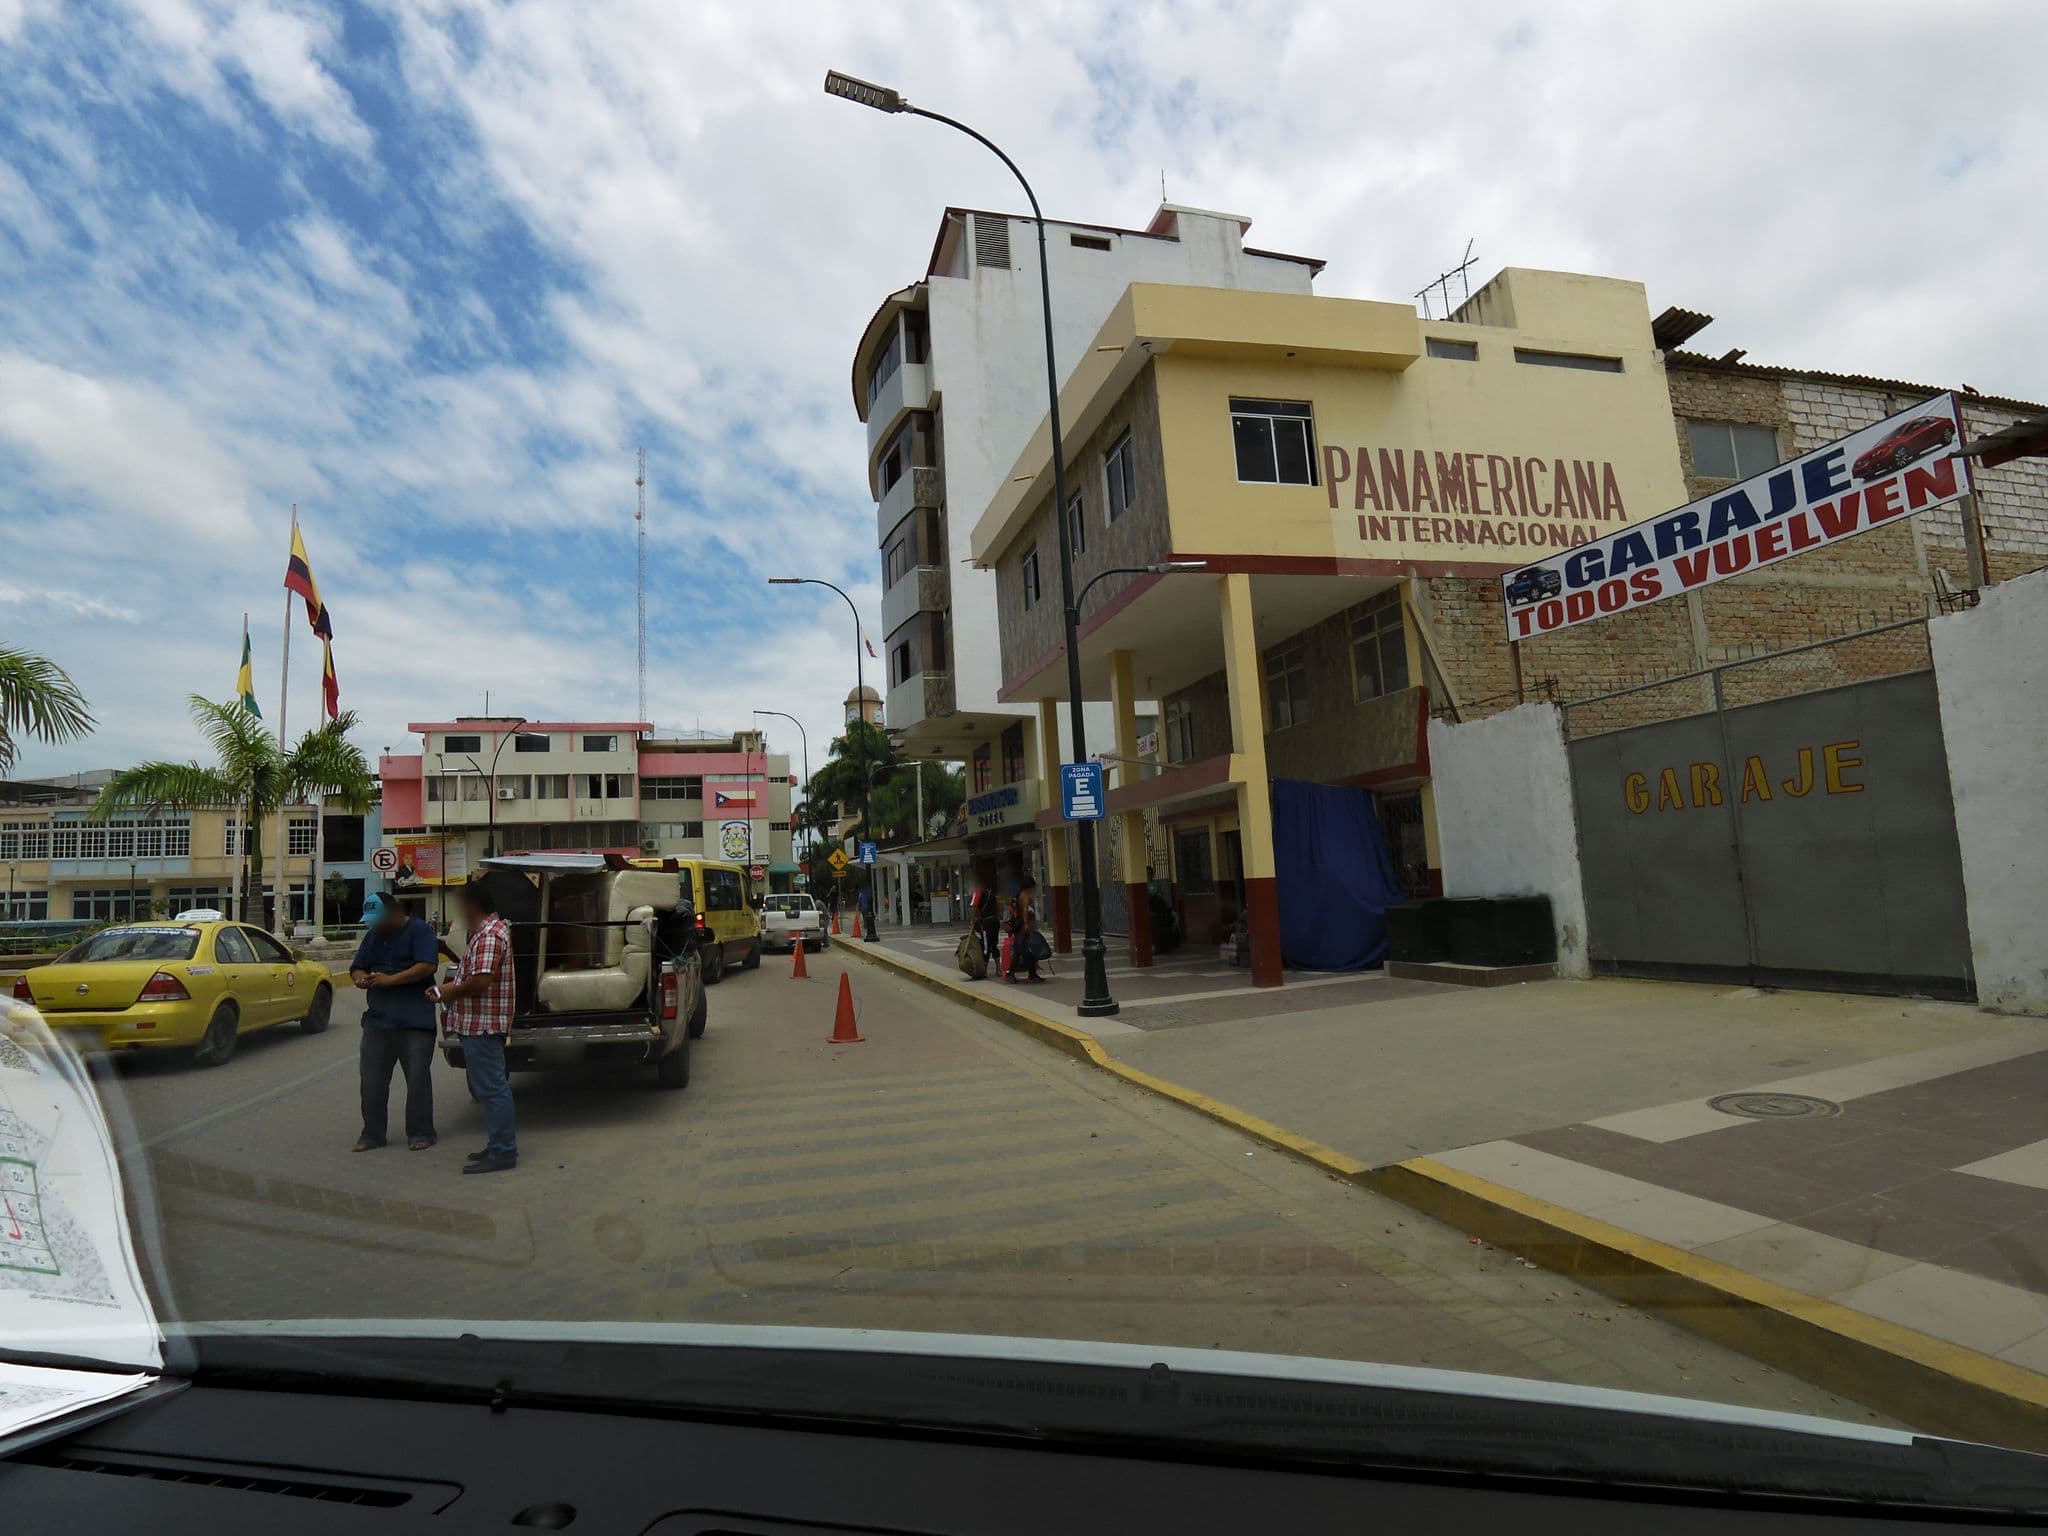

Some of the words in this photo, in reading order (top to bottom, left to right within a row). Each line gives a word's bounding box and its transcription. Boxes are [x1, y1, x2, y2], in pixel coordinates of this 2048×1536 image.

[1323, 445, 1627, 522] PANAMERICANA
[1564, 446, 1853, 589] GARAJE
[1511, 566, 1663, 637] TODOS
[1672, 455, 1959, 588] VUELVEN
[1075, 778, 1090, 795] E
[1624, 740, 1864, 814] GARAJE
